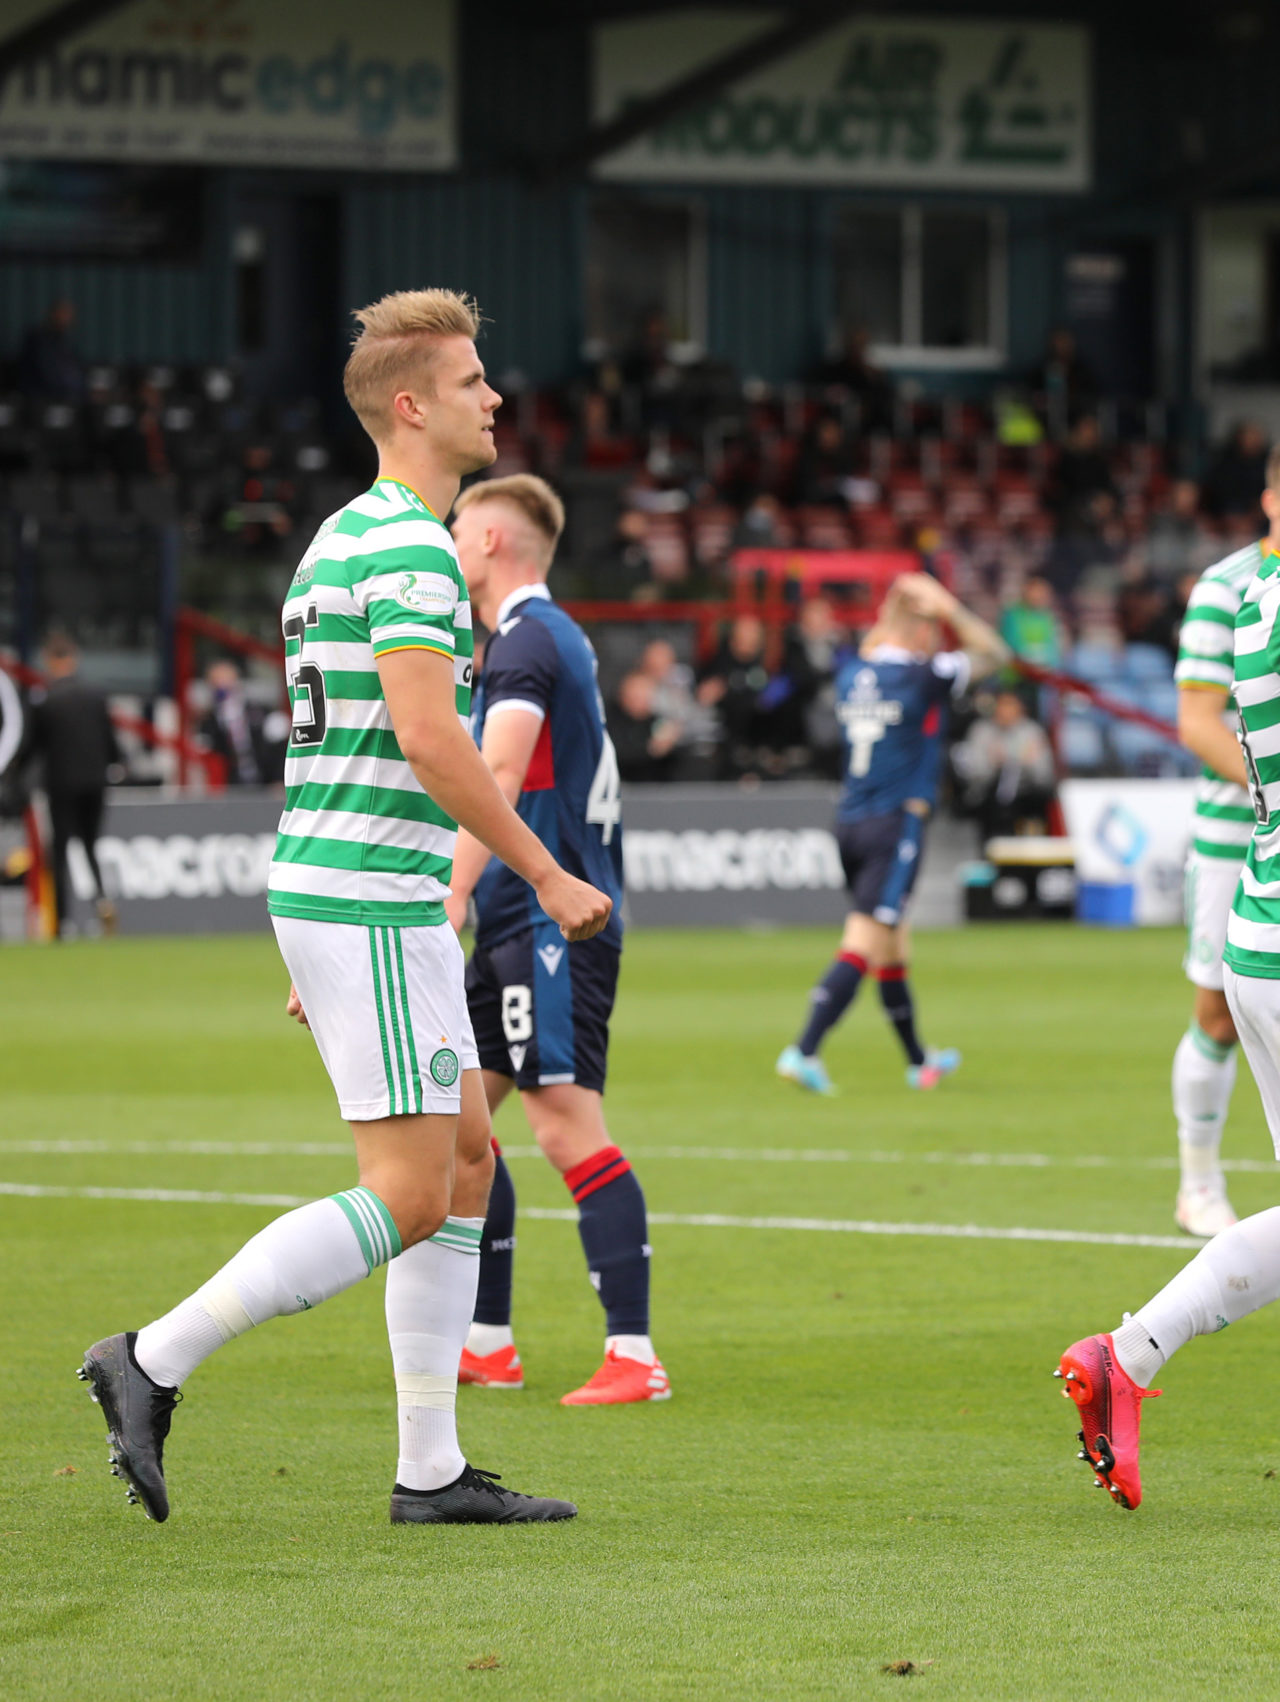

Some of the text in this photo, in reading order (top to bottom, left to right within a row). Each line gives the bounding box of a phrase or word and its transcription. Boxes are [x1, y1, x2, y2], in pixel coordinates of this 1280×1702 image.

[834, 36, 948, 96] AIR
[620, 94, 942, 162] RODUCTS
[622, 828, 846, 892] macron
[501, 984, 533, 1043] 8
